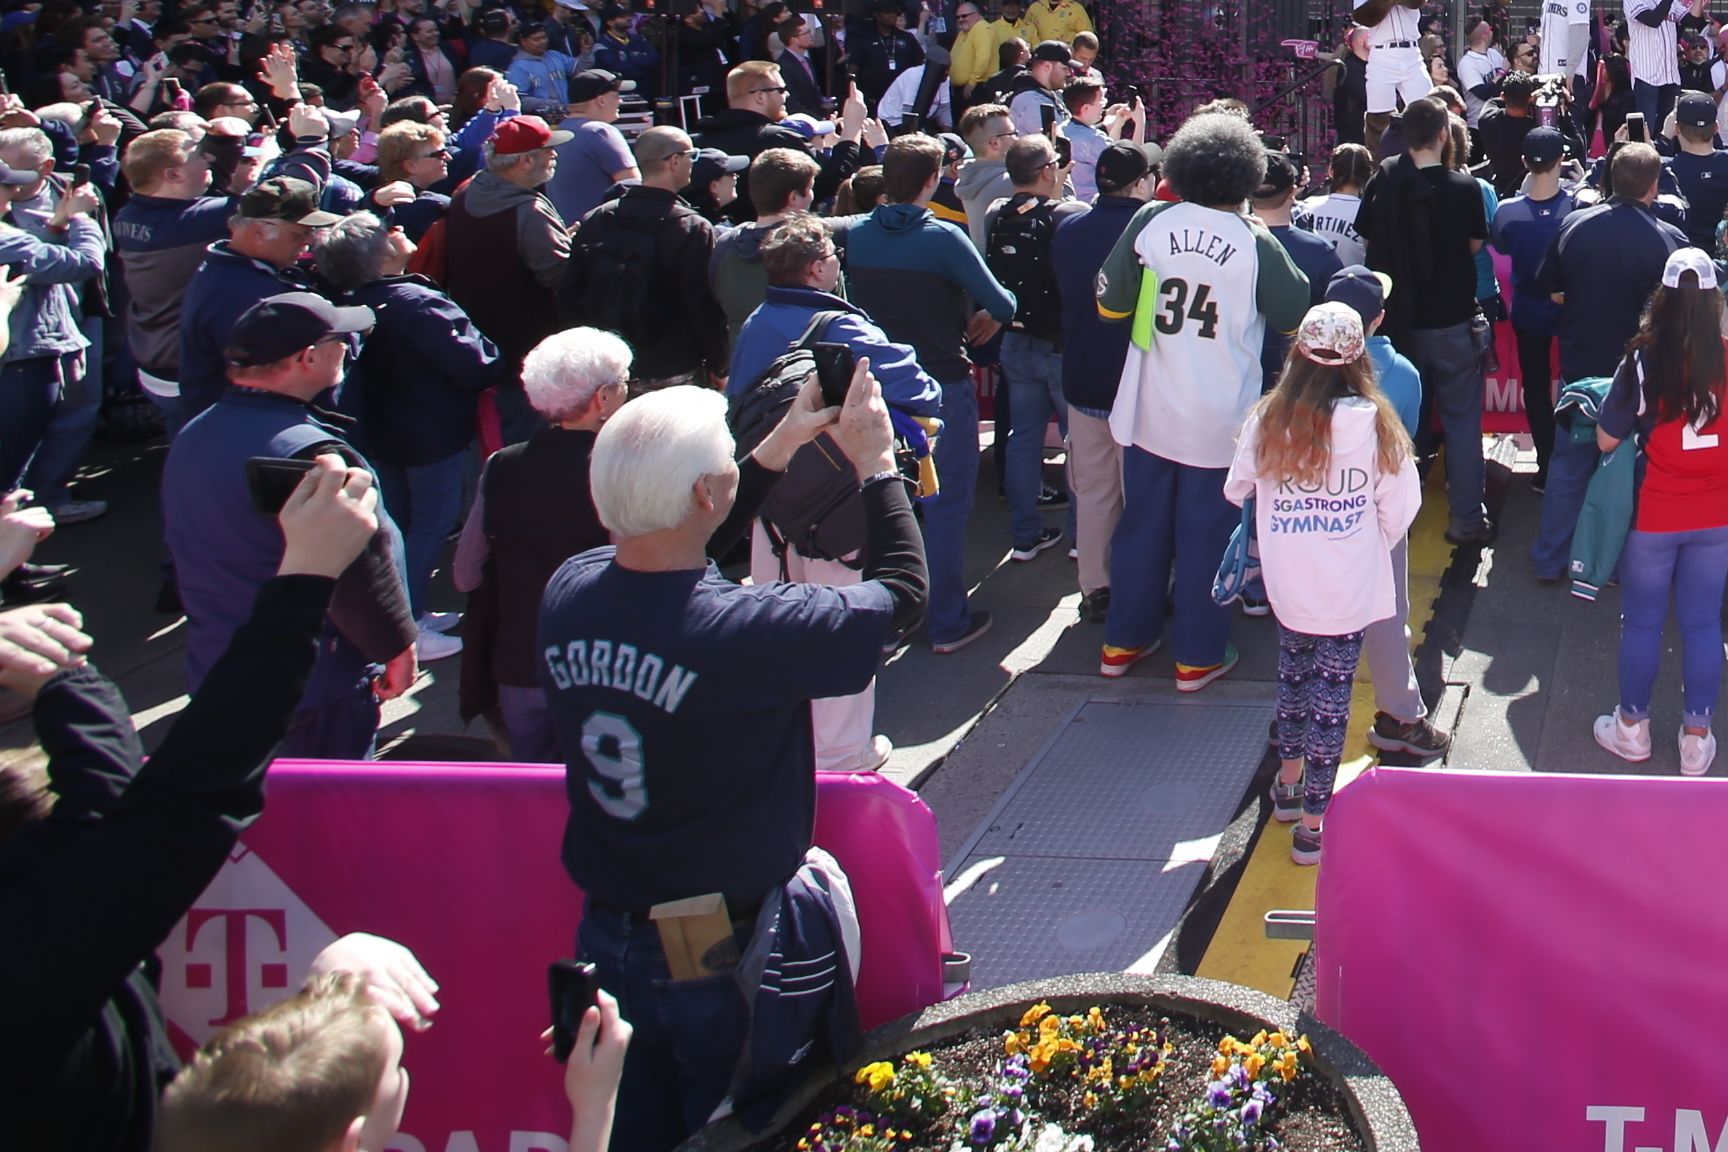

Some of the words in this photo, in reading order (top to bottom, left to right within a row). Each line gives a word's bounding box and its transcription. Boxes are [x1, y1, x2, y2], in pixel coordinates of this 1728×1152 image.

[1169, 229, 1237, 267] ALLEN
[1155, 277, 1219, 340] 34
[1271, 510, 1364, 534] GYMNAST
[545, 639, 699, 715] GORDON
[581, 710, 649, 822] 9
